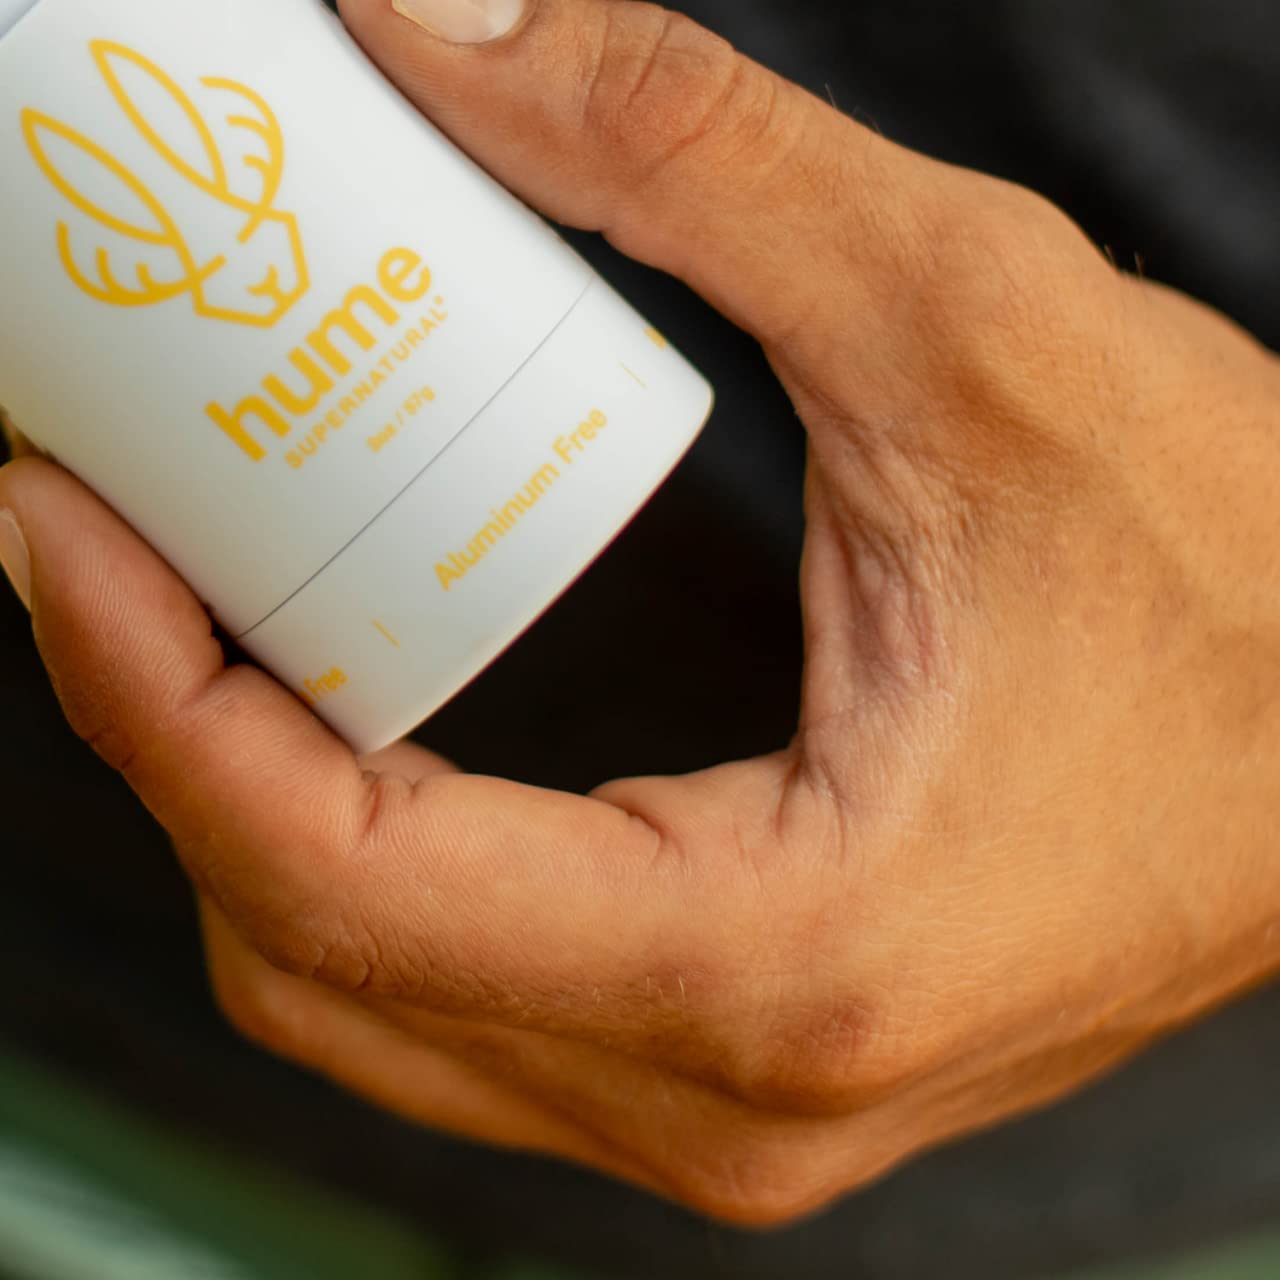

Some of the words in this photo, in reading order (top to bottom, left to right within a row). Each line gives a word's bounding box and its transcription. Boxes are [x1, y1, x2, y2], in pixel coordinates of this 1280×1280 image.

[204, 246, 432, 462] hume
[433, 463, 560, 592] Aluminum
[552, 408, 608, 464] Free
